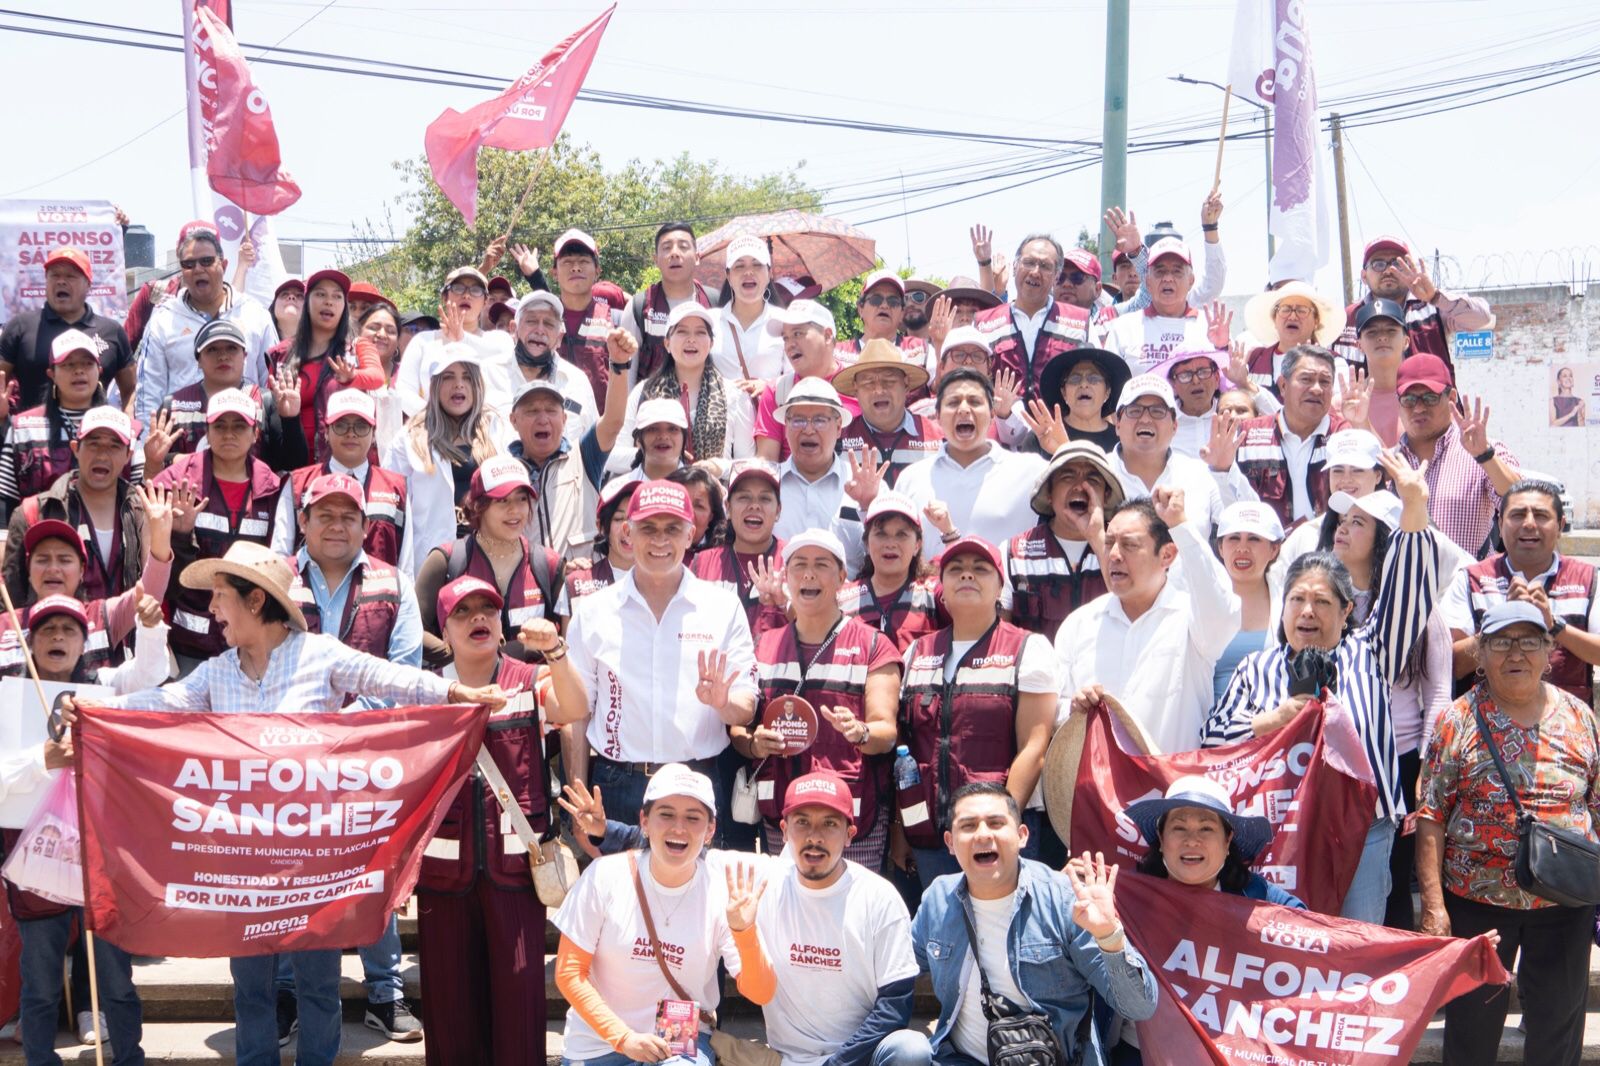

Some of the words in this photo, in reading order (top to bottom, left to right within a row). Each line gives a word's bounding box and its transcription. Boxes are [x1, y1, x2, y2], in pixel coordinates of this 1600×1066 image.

[39, 212, 87, 223] VOTA
[18, 231, 113, 246] ALFONSO
[18, 247, 115, 266] SÁEZ
[1456, 338, 1483, 347] CALLE
[1485, 338, 1492, 347] 8
[908, 439, 943, 449] morena
[639, 486, 686, 499] ALFONSO
[677, 632, 714, 641] MORENA
[972, 654, 1014, 666] morena
[604, 670, 617, 758] ALFONSO
[771, 719, 808, 729] ALFONSO
[263, 734, 319, 745] VOTA
[173, 757, 404, 792] ALFONSO
[1208, 763, 1214, 771] 2
[1216, 762, 1228, 770] DE
[795, 779, 837, 792] morena
[172, 793, 404, 837] SÁNCHEZ
[187, 843, 252, 856] PRESIDENTE
[255, 847, 314, 857] MUNICIPAL
[316, 848, 331, 857] DE
[333, 838, 377, 856] TLAXCALA
[270, 858, 304, 866] CANDIDATO
[194, 871, 279, 887] HONESTIDAD
[281, 877, 291, 886] Y
[293, 864, 366, 886] RESULTADOS
[175, 889, 210, 905] POR
[214, 893, 252, 907] UNA
[256, 891, 311, 907] MEJOR
[314, 877, 374, 900] CAPITAL
[244, 914, 309, 936] morena
[1268, 920, 1274, 928] 2
[1277, 921, 1292, 931] DE
[1294, 926, 1328, 937] JUNIO
[1266, 928, 1325, 953] VOTA
[632, 946, 683, 966] SÁNHEZ
[790, 943, 841, 957] ALFONSO
[790, 953, 842, 968] SÁNCHEZ
[1163, 939, 1410, 1005] ALFONSO
[1171, 983, 1405, 1057] ÁNCHEZ
[1335, 1016, 1346, 1047] GARCÍA
[1234, 1050, 1295, 1066] MUNICIPAL
